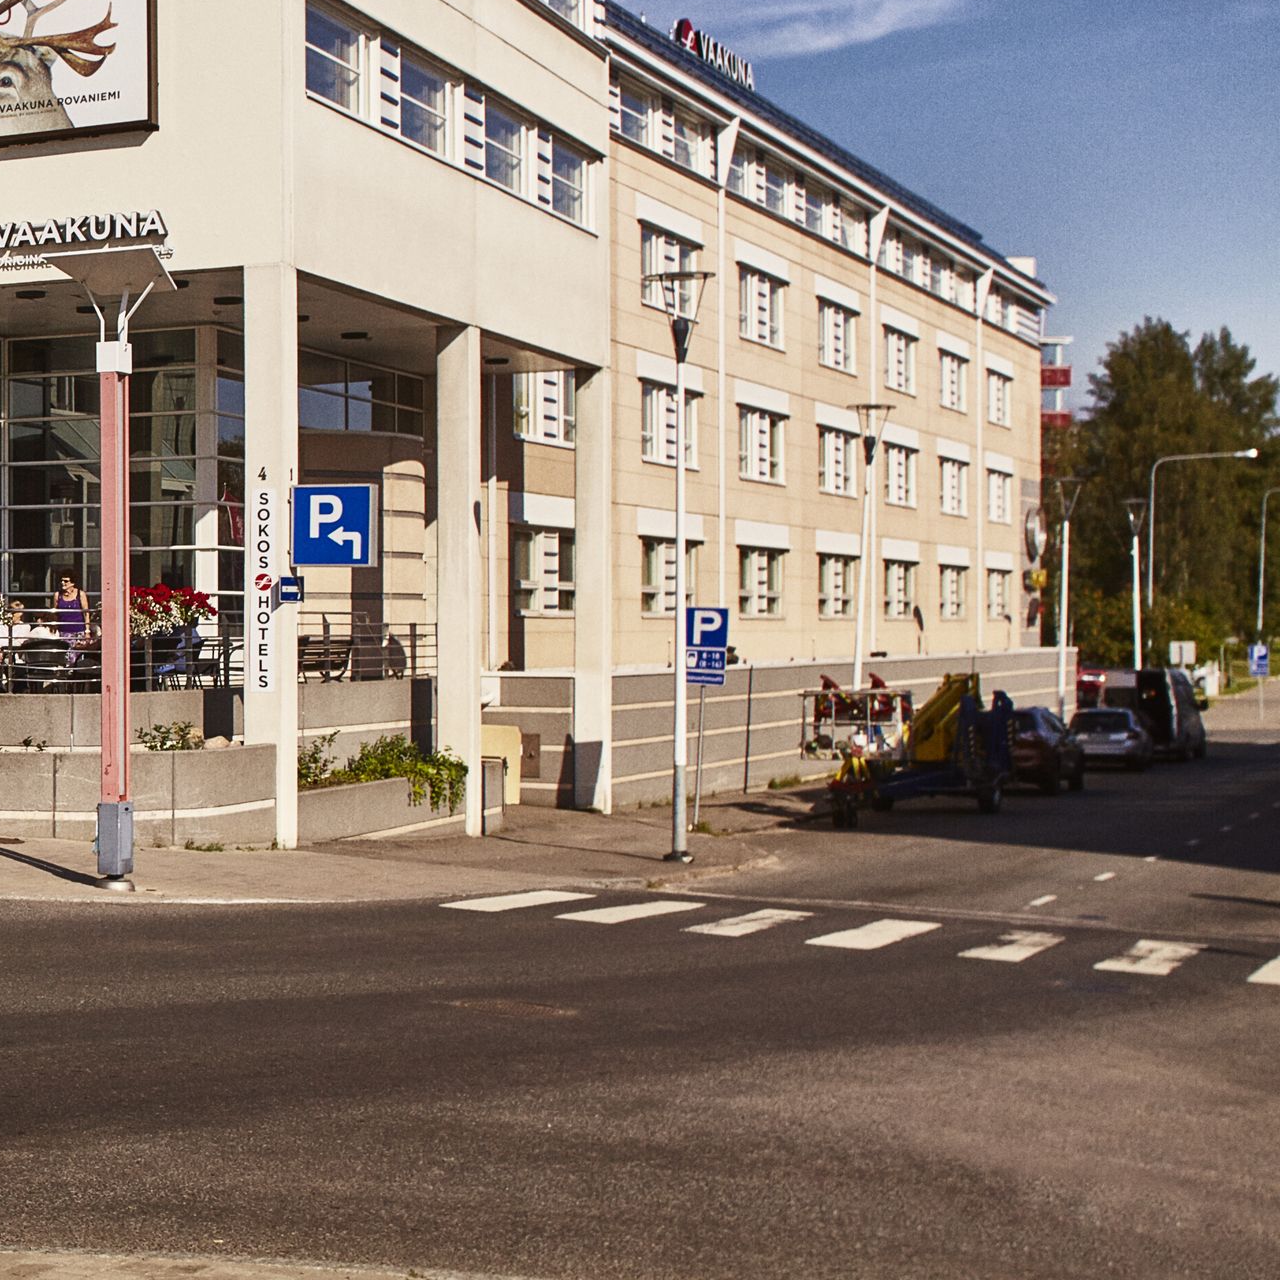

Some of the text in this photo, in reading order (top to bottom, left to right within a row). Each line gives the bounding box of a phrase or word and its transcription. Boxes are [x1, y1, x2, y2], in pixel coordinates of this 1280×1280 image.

[700, 30, 755, 92] VAAKUNA
[57, 90, 122, 107] ROVANIEMI
[258, 466, 267, 481] 4
[309, 494, 344, 539] P
[257, 492, 270, 688] SOKOS HOTELS
[692, 609, 723, 646] P
